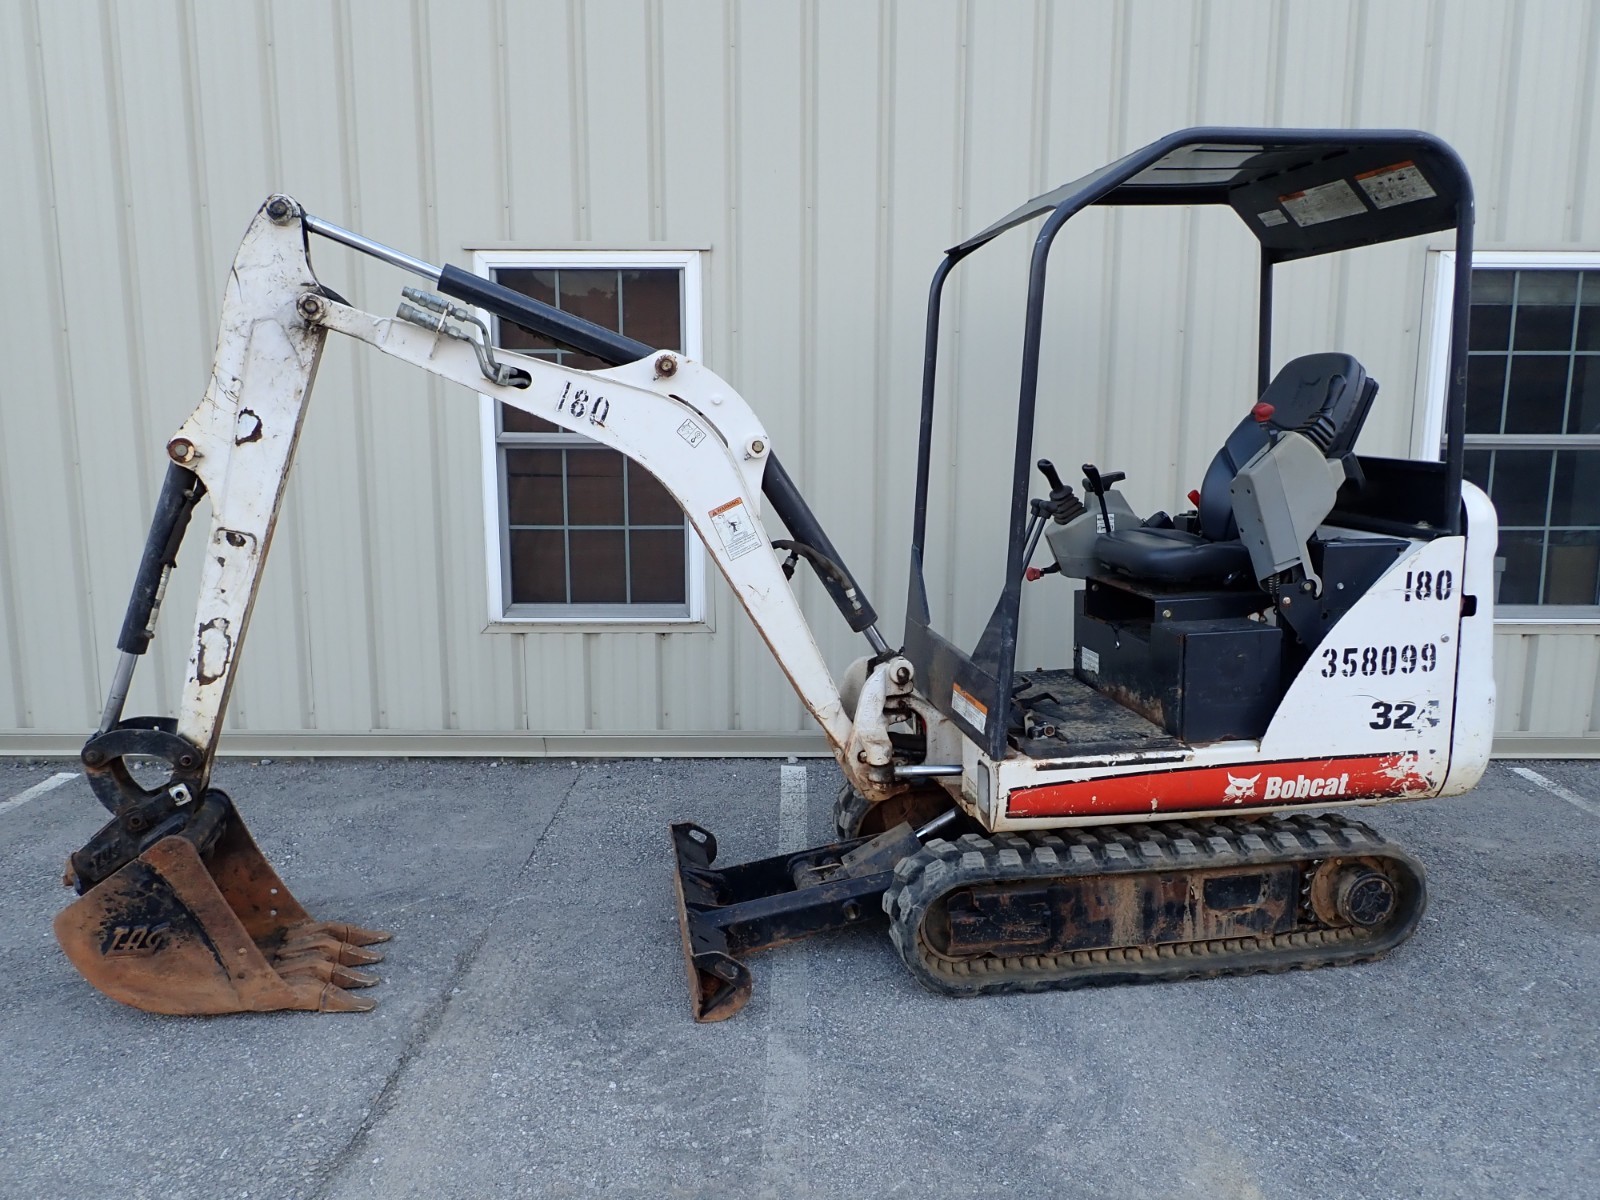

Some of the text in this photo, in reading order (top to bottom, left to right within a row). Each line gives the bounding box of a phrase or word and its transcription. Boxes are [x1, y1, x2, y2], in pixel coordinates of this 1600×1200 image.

[557, 381, 609, 426] 180
[1404, 570, 1452, 602] 180
[1321, 643, 1437, 678] 358099
[1264, 773, 1349, 800] Bobcat
